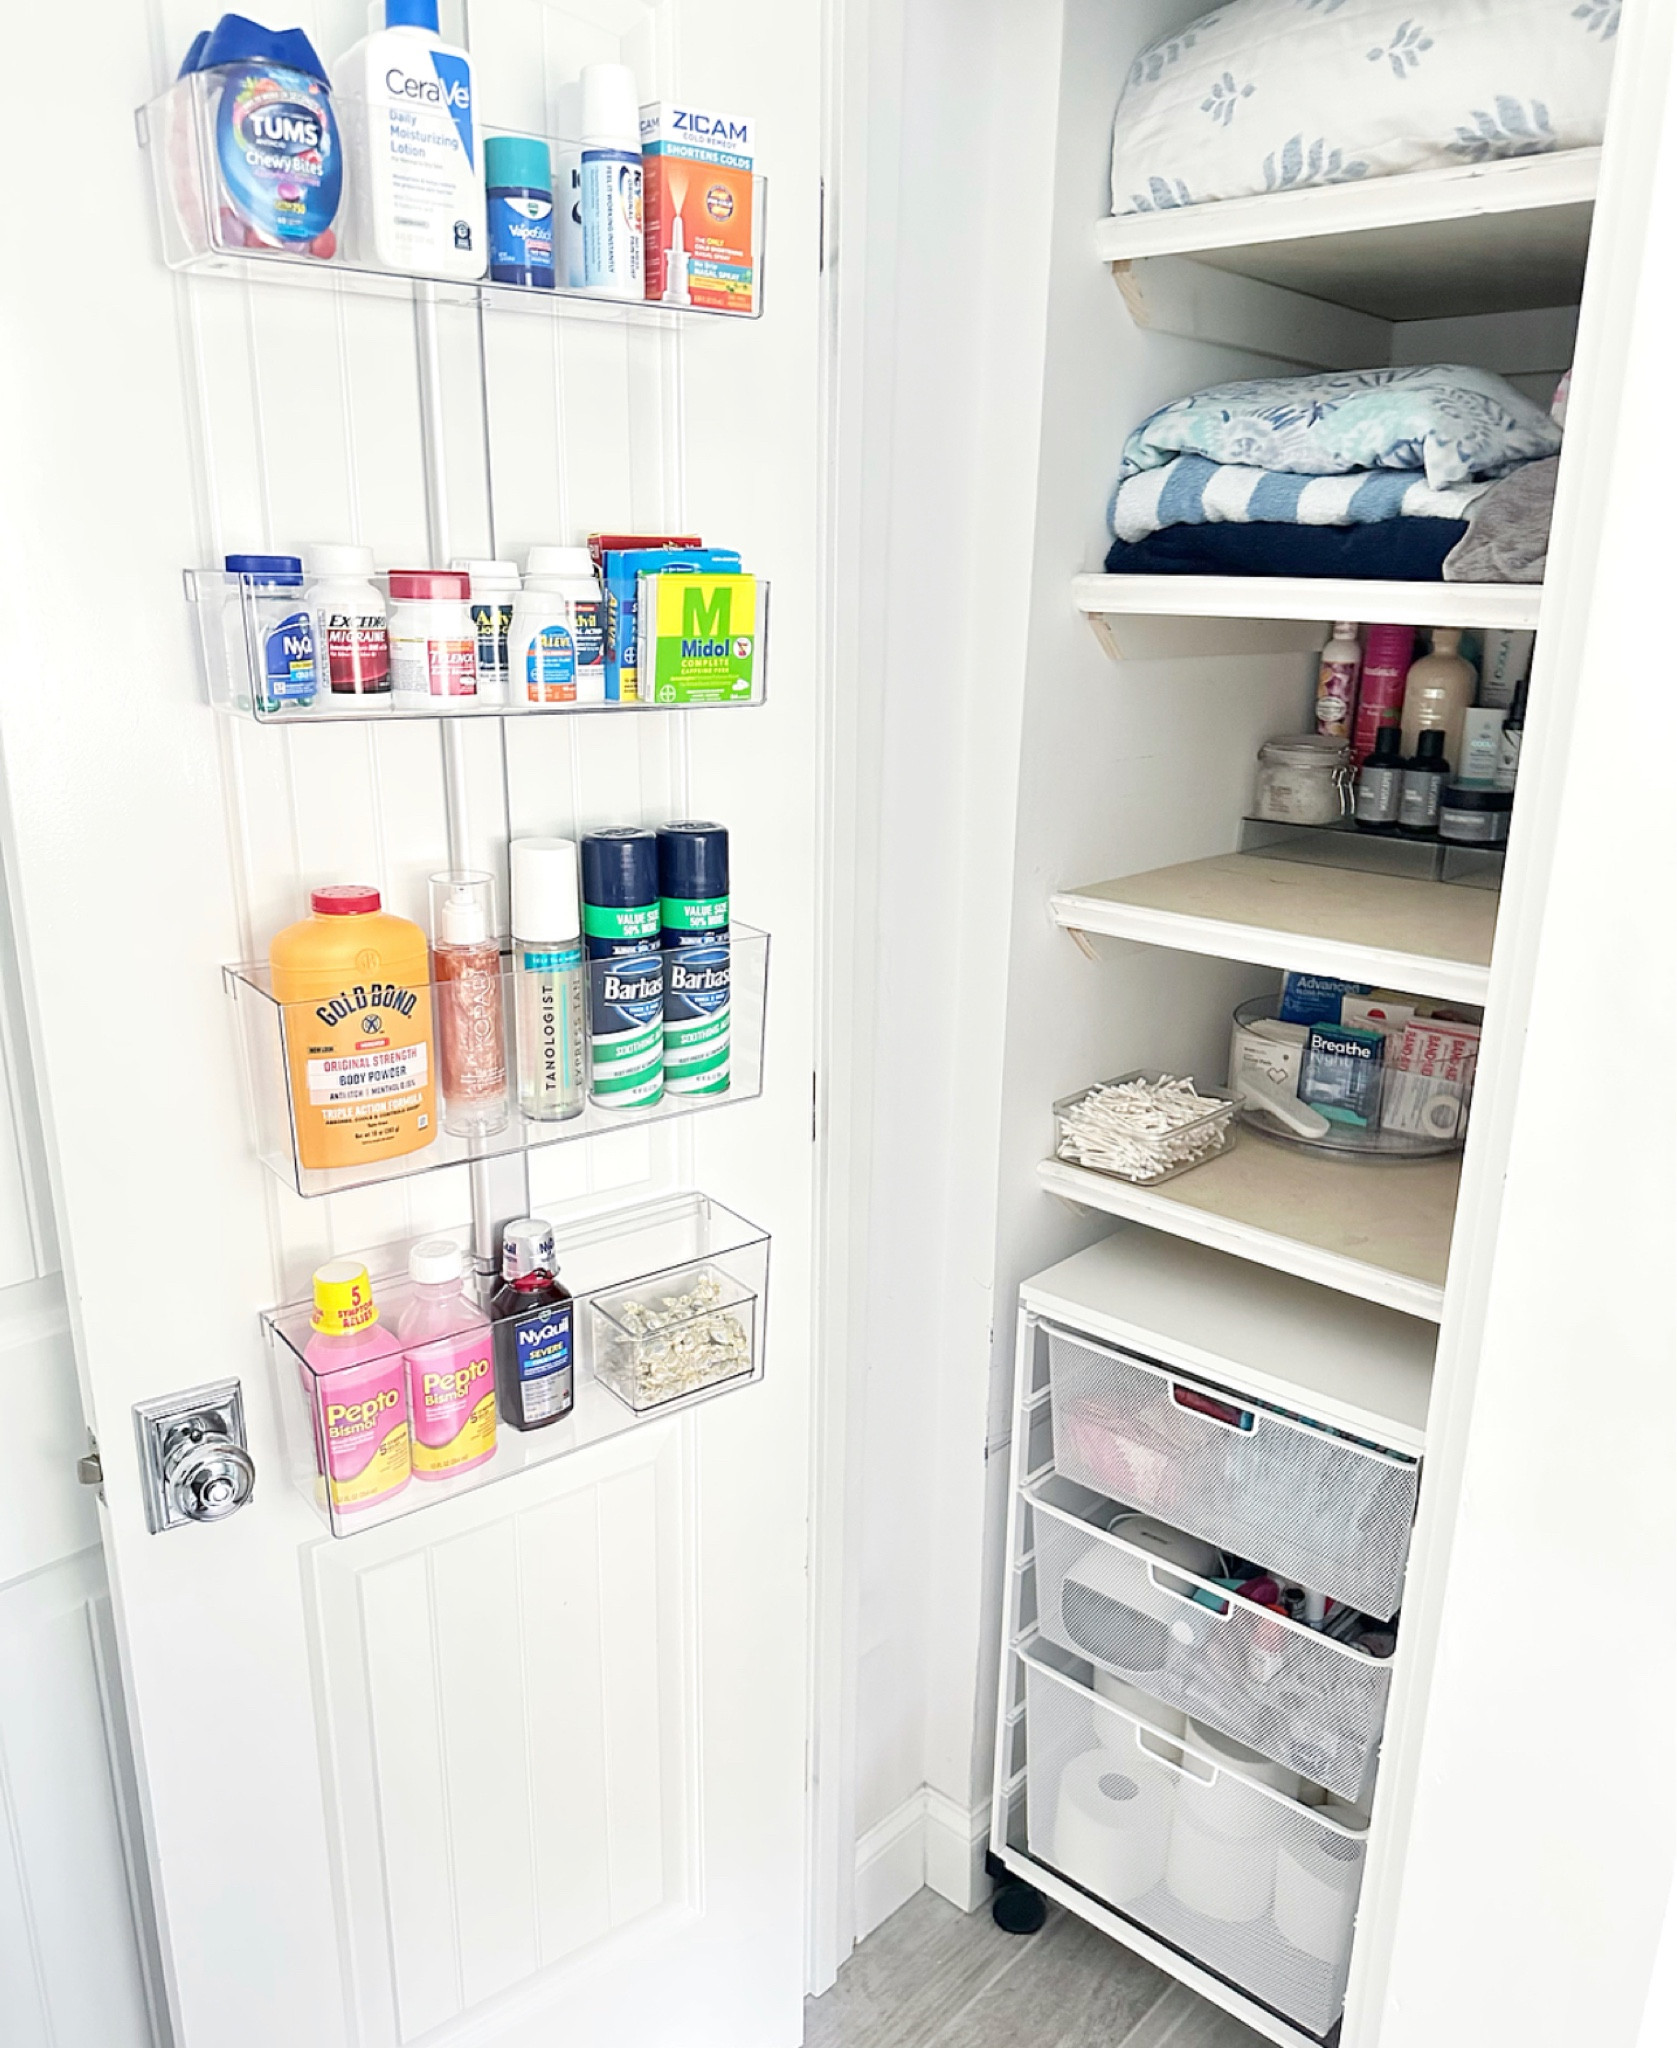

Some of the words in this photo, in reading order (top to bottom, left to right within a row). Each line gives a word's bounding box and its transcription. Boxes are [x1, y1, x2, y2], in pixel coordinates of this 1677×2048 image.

[386, 69, 470, 109] CeraVe
[389, 107, 416, 127] Daily
[673, 110, 747, 143] ZICAM
[249, 113, 318, 146] TUMS
[390, 125, 459, 151] Moisturizing
[391, 140, 426, 157] Lotion
[683, 132, 704, 143] COLD
[707, 138, 736, 149] REMEDY
[246, 151, 291, 173] Chewy
[293, 158, 324, 176] Bites
[667, 143, 717, 163] SHORTENS
[720, 155, 751, 170] COLDS
[330, 631, 386, 643] MIGRAINE
[682, 639, 730, 657] Midol
[681, 659, 729, 667] COMPLETE
[616, 912, 646, 925] VALUE
[684, 905, 712, 916] VALUE
[623, 925, 639, 936] 50%
[690, 917, 706, 926] 50%
[1297, 976, 1360, 994] Advanced
[316, 986, 368, 1027] GOLD
[371, 984, 417, 1016] BOND
[542, 985, 556, 1090] TANOLOGIST
[1312, 1033, 1371, 1058] Breathe
[323, 1056, 370, 1072] ORIGINAL
[372, 1047, 417, 1066] STRENGTH
[339, 1072, 366, 1086] BODY
[368, 1066, 407, 1082] POWDER
[352, 1285, 361, 1306] 5
[338, 1300, 373, 1318] SYMPTOM
[343, 1309, 372, 1328] RELIEF
[519, 1316, 569, 1347] NyQuil
[529, 1340, 564, 1360] SEVERE
[422, 1359, 490, 1395] Pepto
[424, 1383, 470, 1407] Bismol
[327, 1389, 399, 1426] Pepto
[329, 1414, 376, 1438] Bismol
